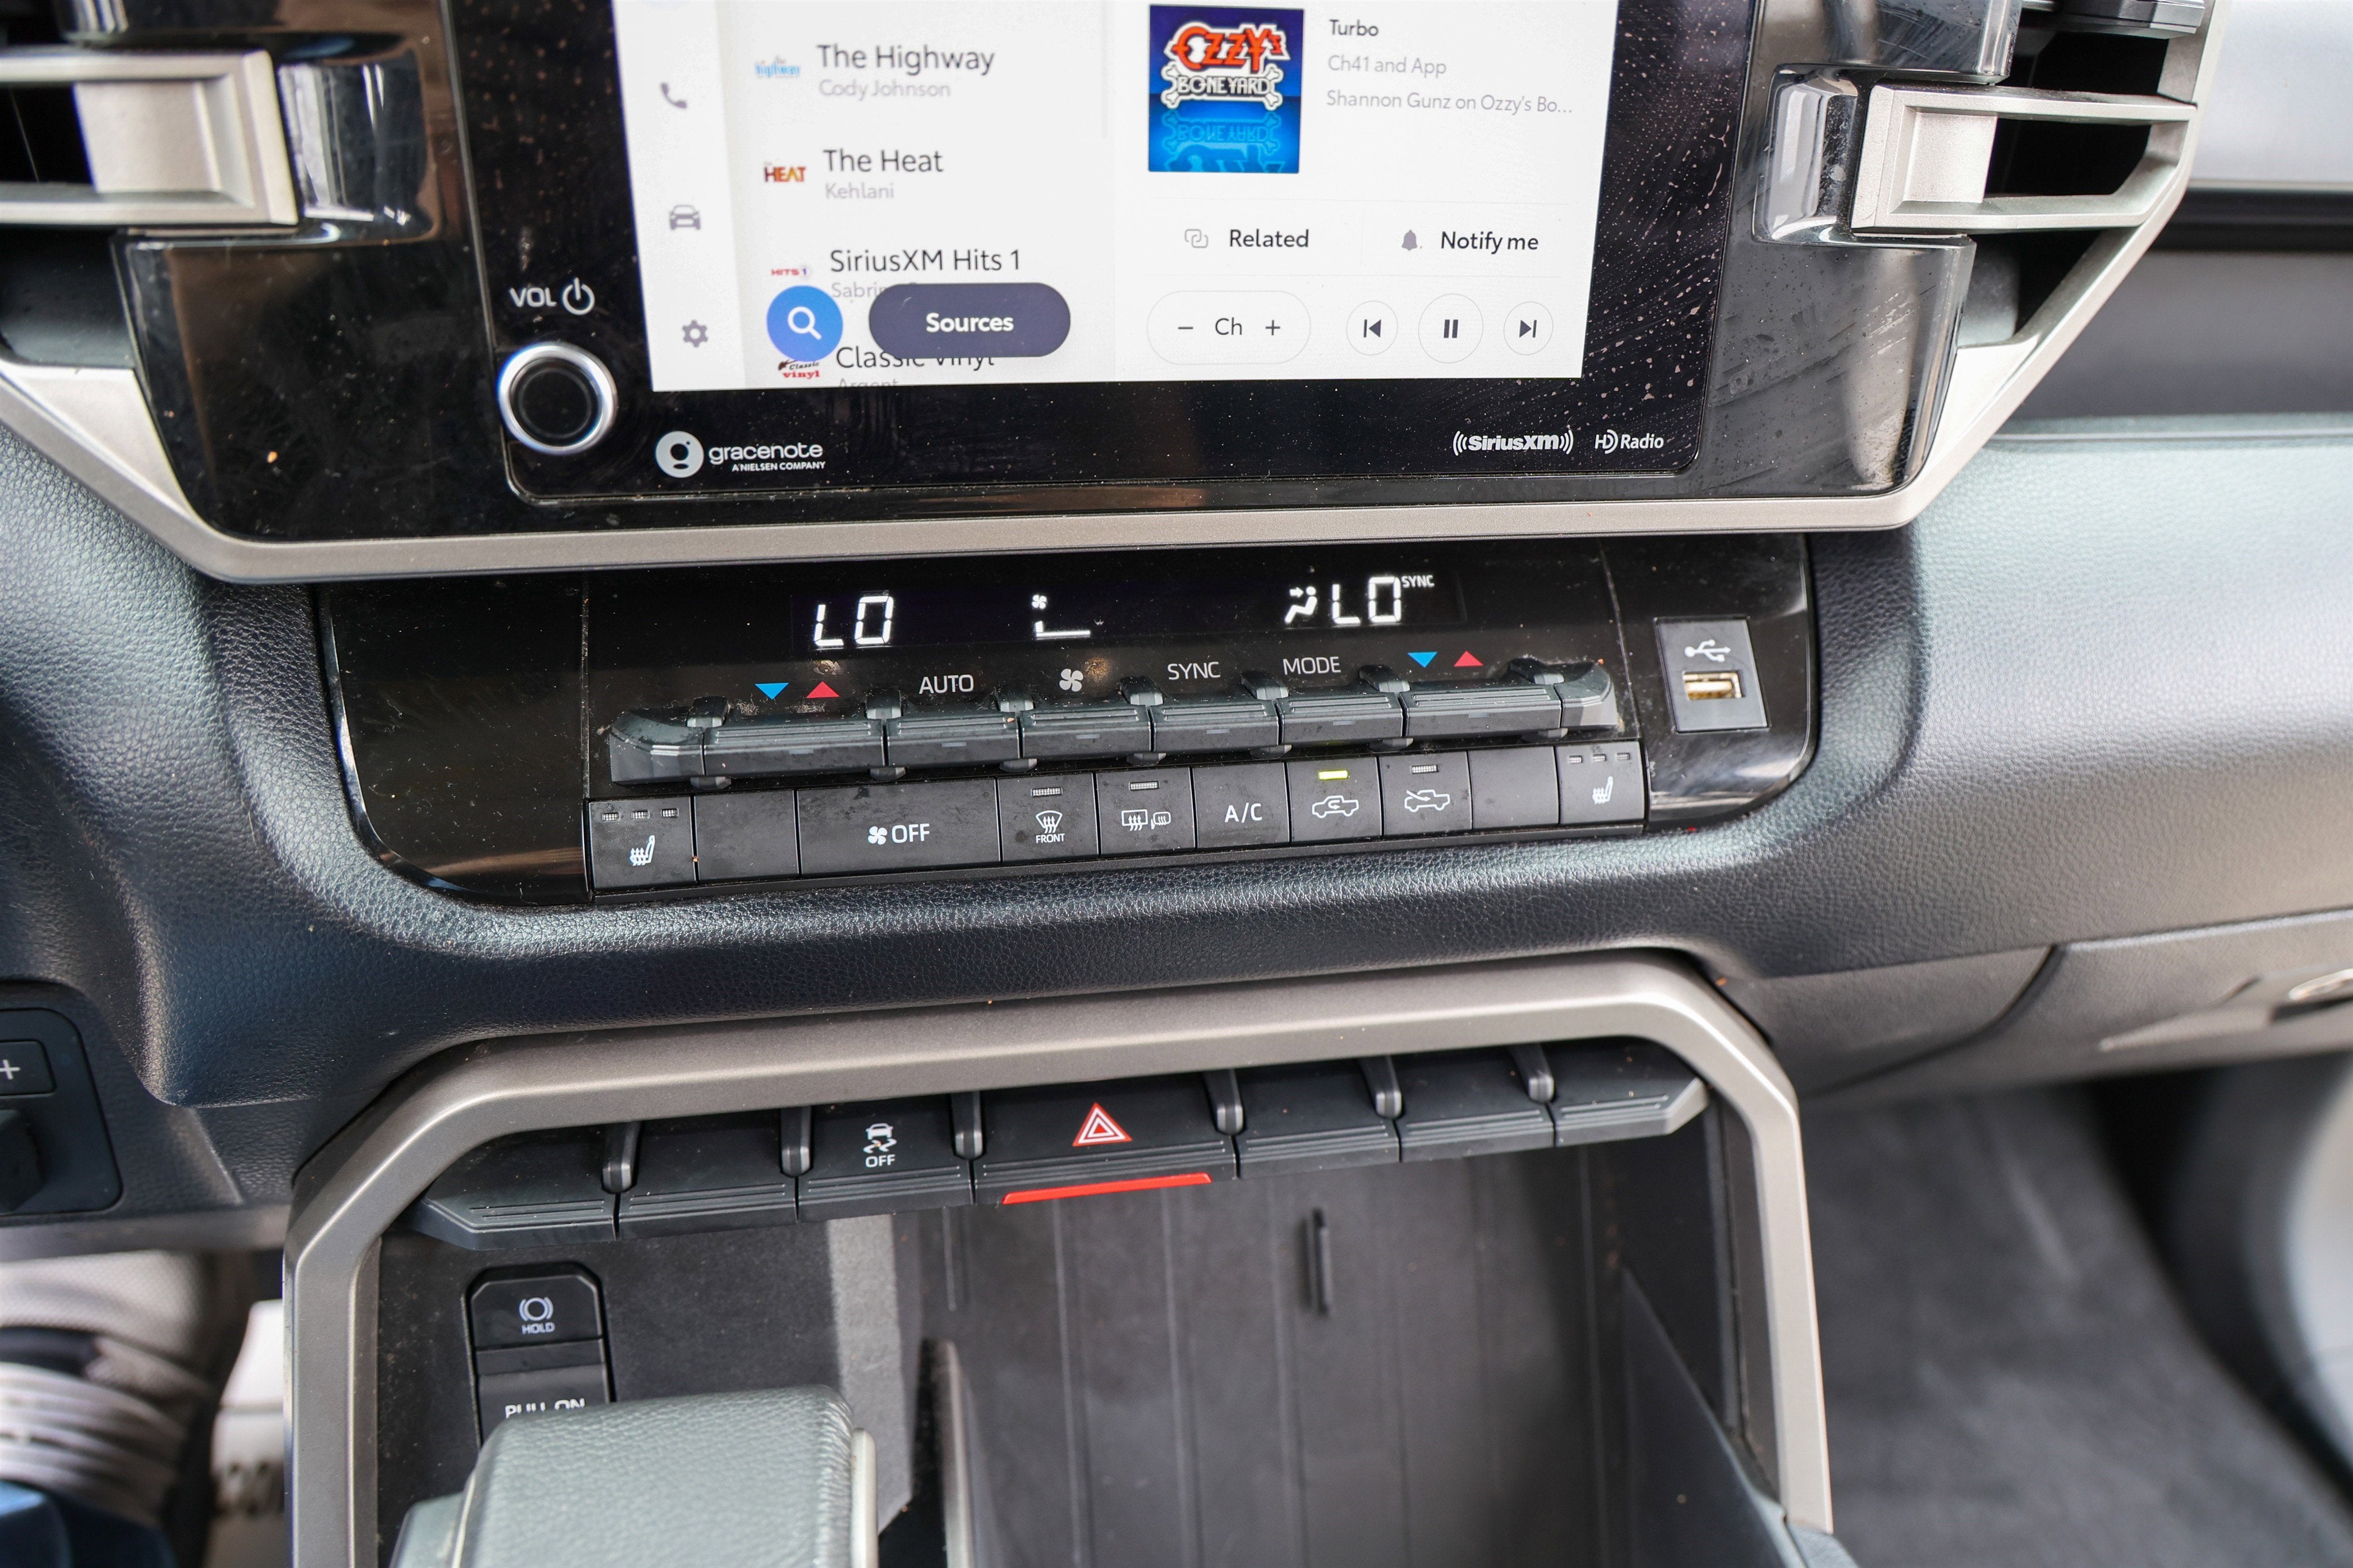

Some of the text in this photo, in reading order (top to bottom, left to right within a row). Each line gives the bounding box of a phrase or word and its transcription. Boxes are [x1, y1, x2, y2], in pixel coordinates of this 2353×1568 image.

[1329, 19, 1379, 37] Turbo
[817, 44, 994, 76] The Highway
[1328, 54, 1447, 79] Ch41 and App
[818, 78, 951, 102] Cody Johnson
[1326, 89, 1402, 107] Shannon
[1406, 92, 1451, 109] Gunz
[1455, 98, 1476, 110] on
[1480, 94, 1532, 116] Ozzy's
[823, 148, 943, 172] The Heat
[763, 166, 807, 183] HEAT
[825, 181, 894, 199] Kehlani
[1229, 228, 1309, 248] Related
[1441, 231, 1539, 255] Notify me
[830, 249, 1019, 272] SiriusXM Hits 1
[509, 287, 557, 307] VOL
[926, 312, 1015, 333] Sources
[1214, 316, 1243, 335] Ch
[1620, 432, 1664, 449] Radio
[708, 442, 823, 465] gracenote
[739, 462, 778, 472] NIELSEN
[779, 461, 826, 470] COMPANY
[1401, 574, 1434, 588] SYNC
[1167, 661, 1221, 680] SYNC
[1283, 656, 1341, 675] MODE
[919, 674, 974, 694] AUTO
[1224, 802, 1263, 824] A/C
[892, 823, 930, 843] OFF
[1035, 831, 1066, 844] FRONT
[865, 1154, 895, 1168] OFF
[522, 1322, 555, 1334] HOLD
